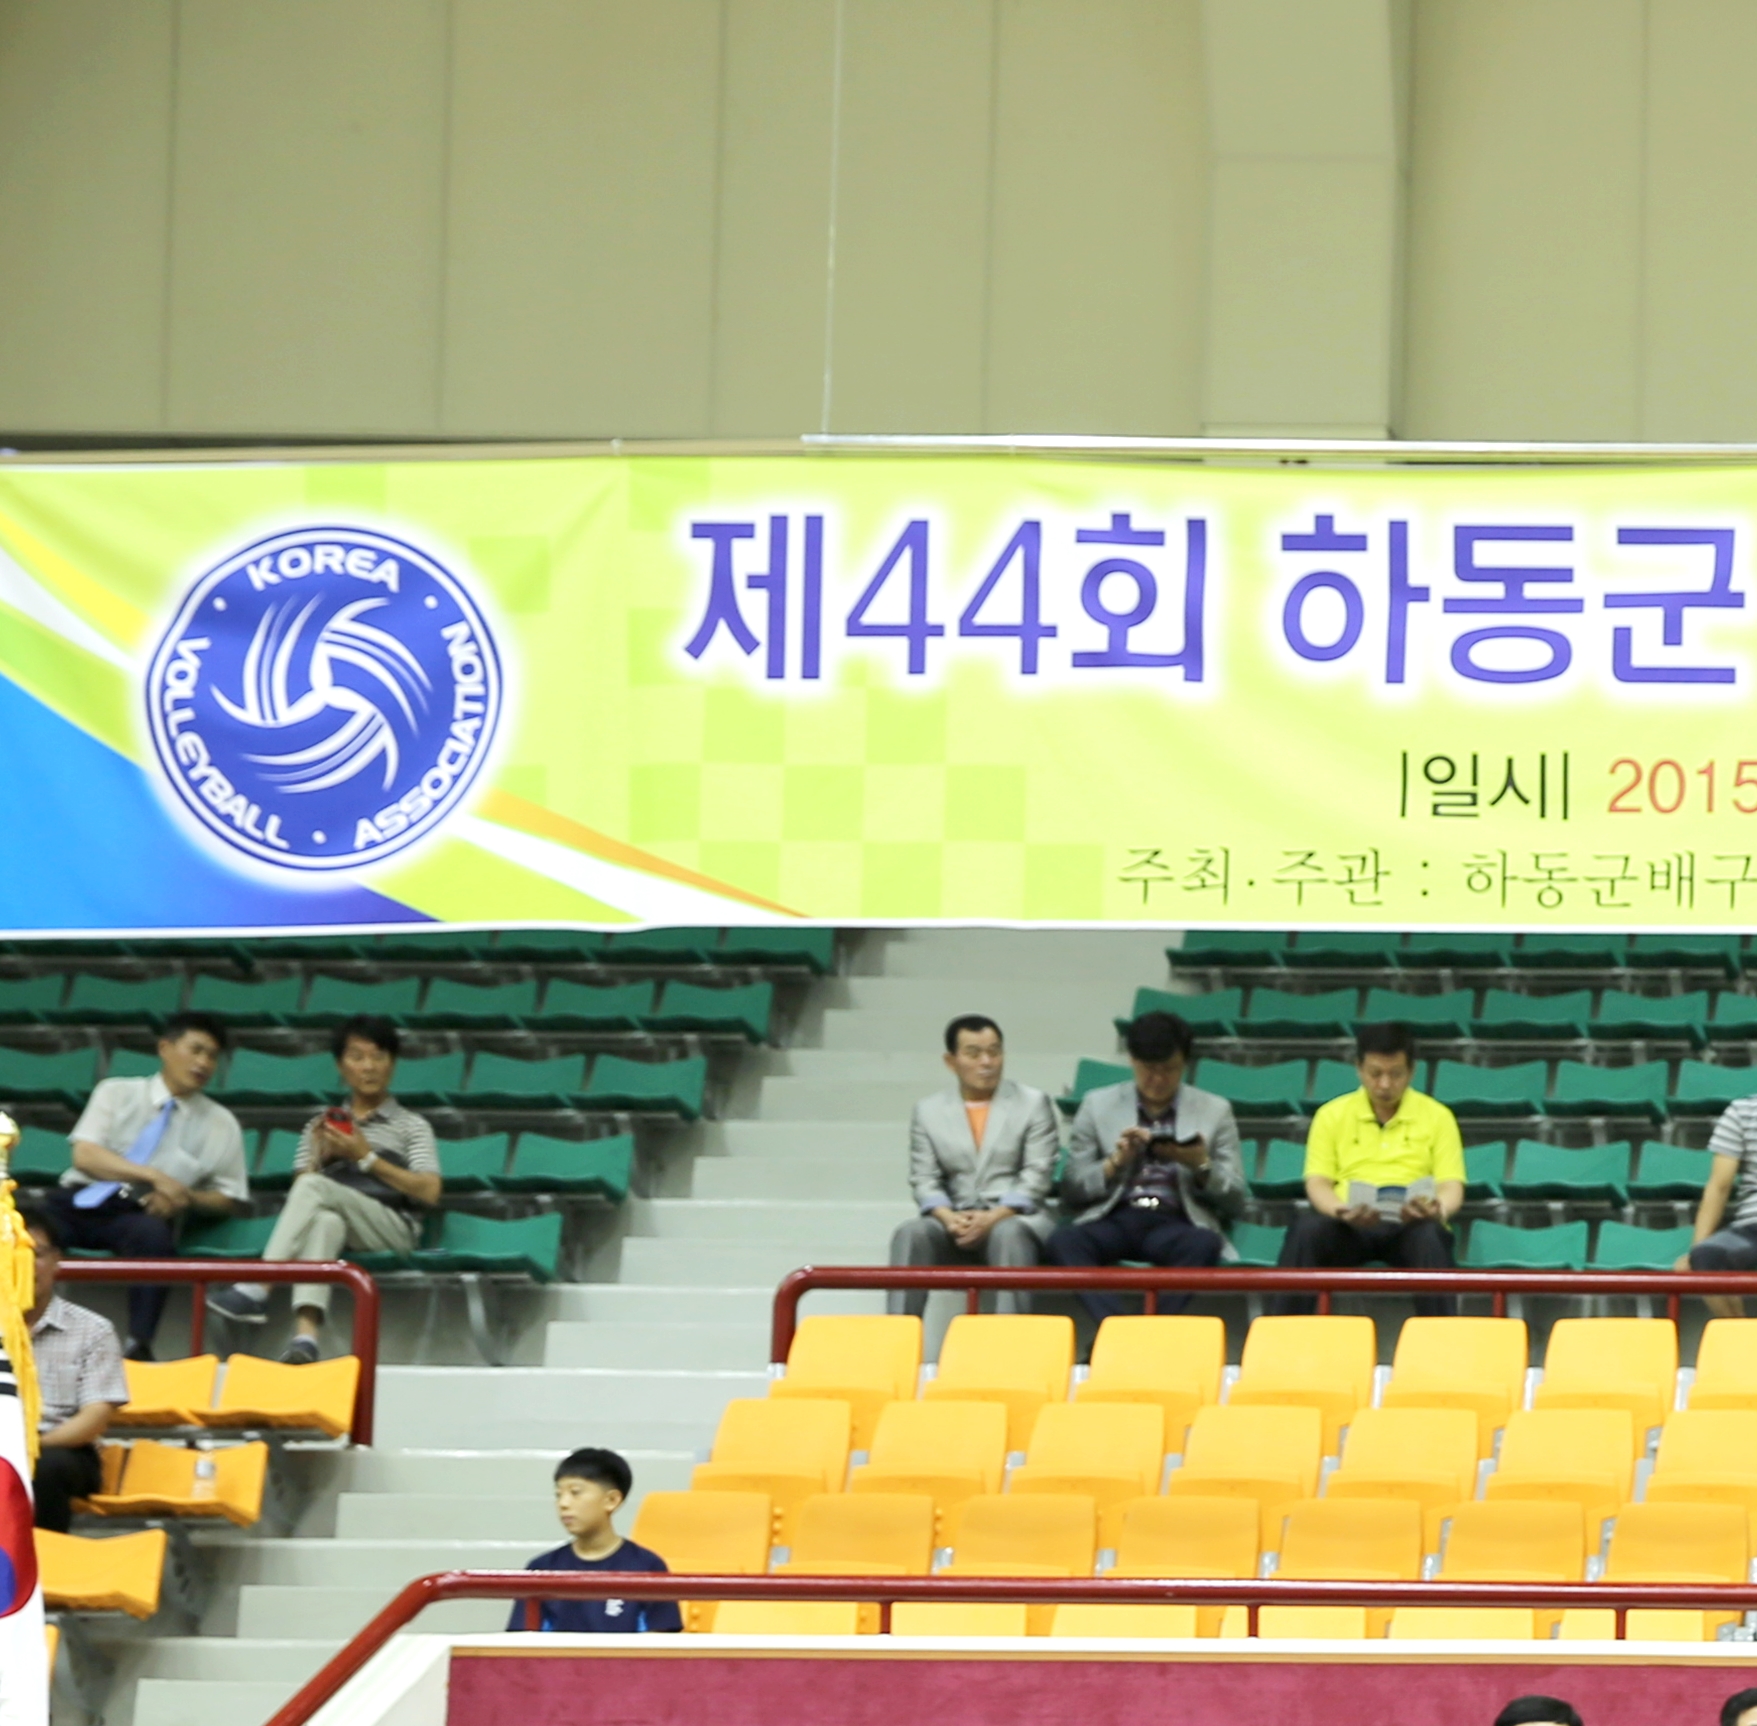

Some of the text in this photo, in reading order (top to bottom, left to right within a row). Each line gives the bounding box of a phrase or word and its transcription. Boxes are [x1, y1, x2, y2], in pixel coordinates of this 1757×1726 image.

[245, 543, 400, 594] KOREA
[685, 512, 1209, 686] 제44회
[1281, 513, 1747, 687] 하동군
[164, 636, 291, 850] VOLLEYBALL
[352, 619, 486, 850] ASSOCIATION
